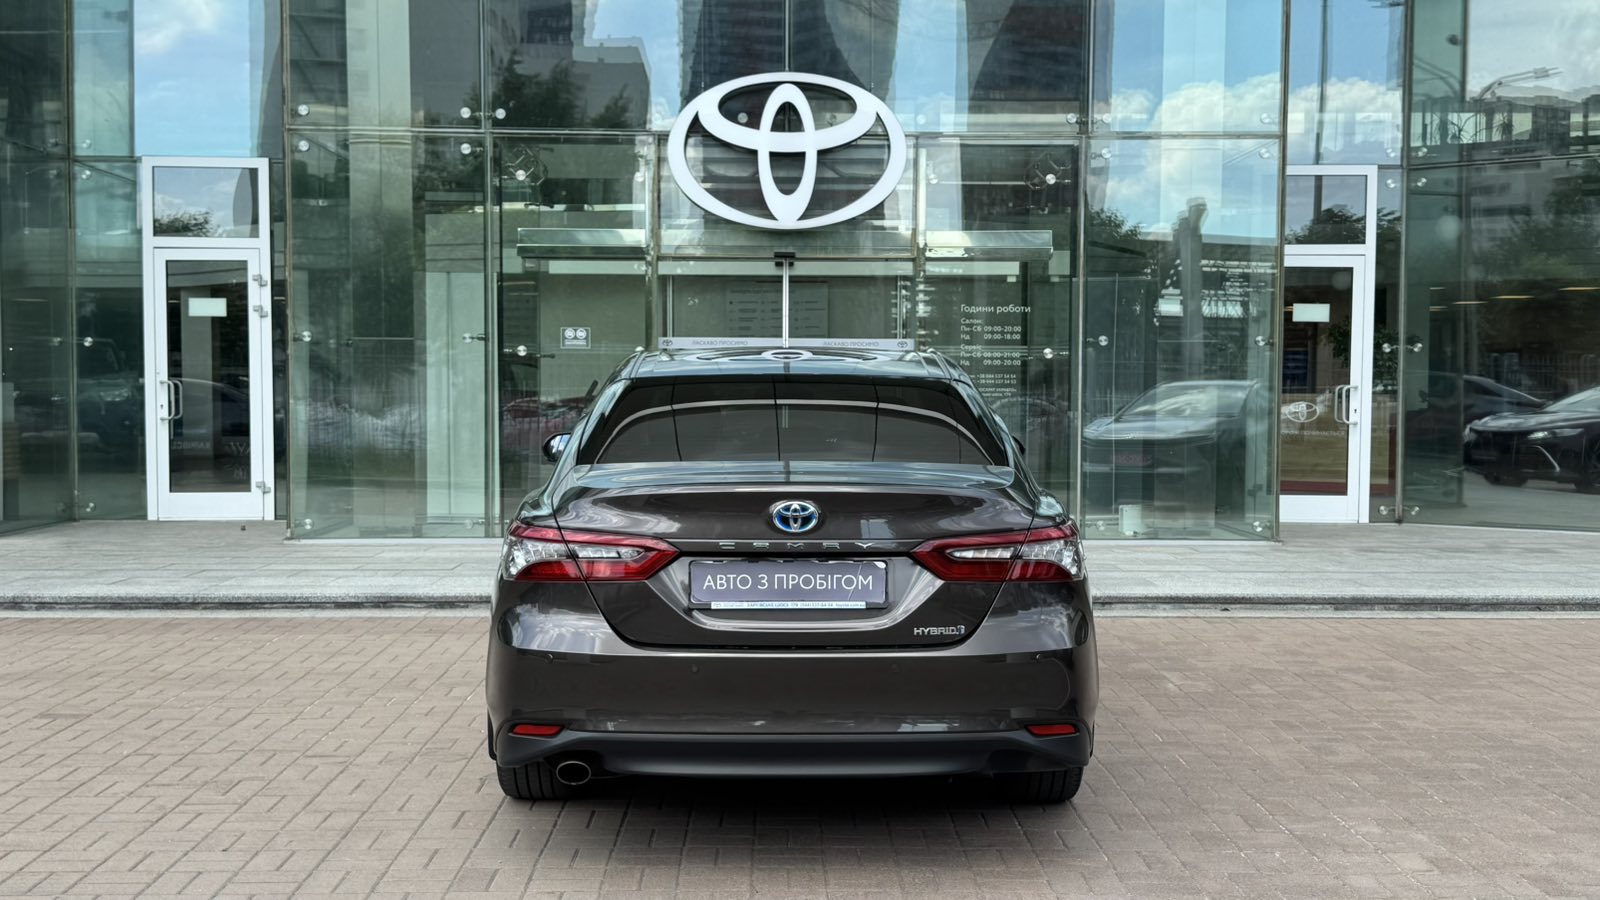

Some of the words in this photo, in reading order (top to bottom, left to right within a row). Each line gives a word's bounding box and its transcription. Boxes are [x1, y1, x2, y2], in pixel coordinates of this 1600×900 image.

[960, 304, 994, 313] Години
[996, 304, 1031, 315] роботи
[719, 542, 875, 550] CAMRY
[703, 574, 752, 590] АВТО
[757, 574, 769, 590] З
[774, 574, 873, 590] ПРОБІГОМ
[913, 626, 958, 636] HYBRID
